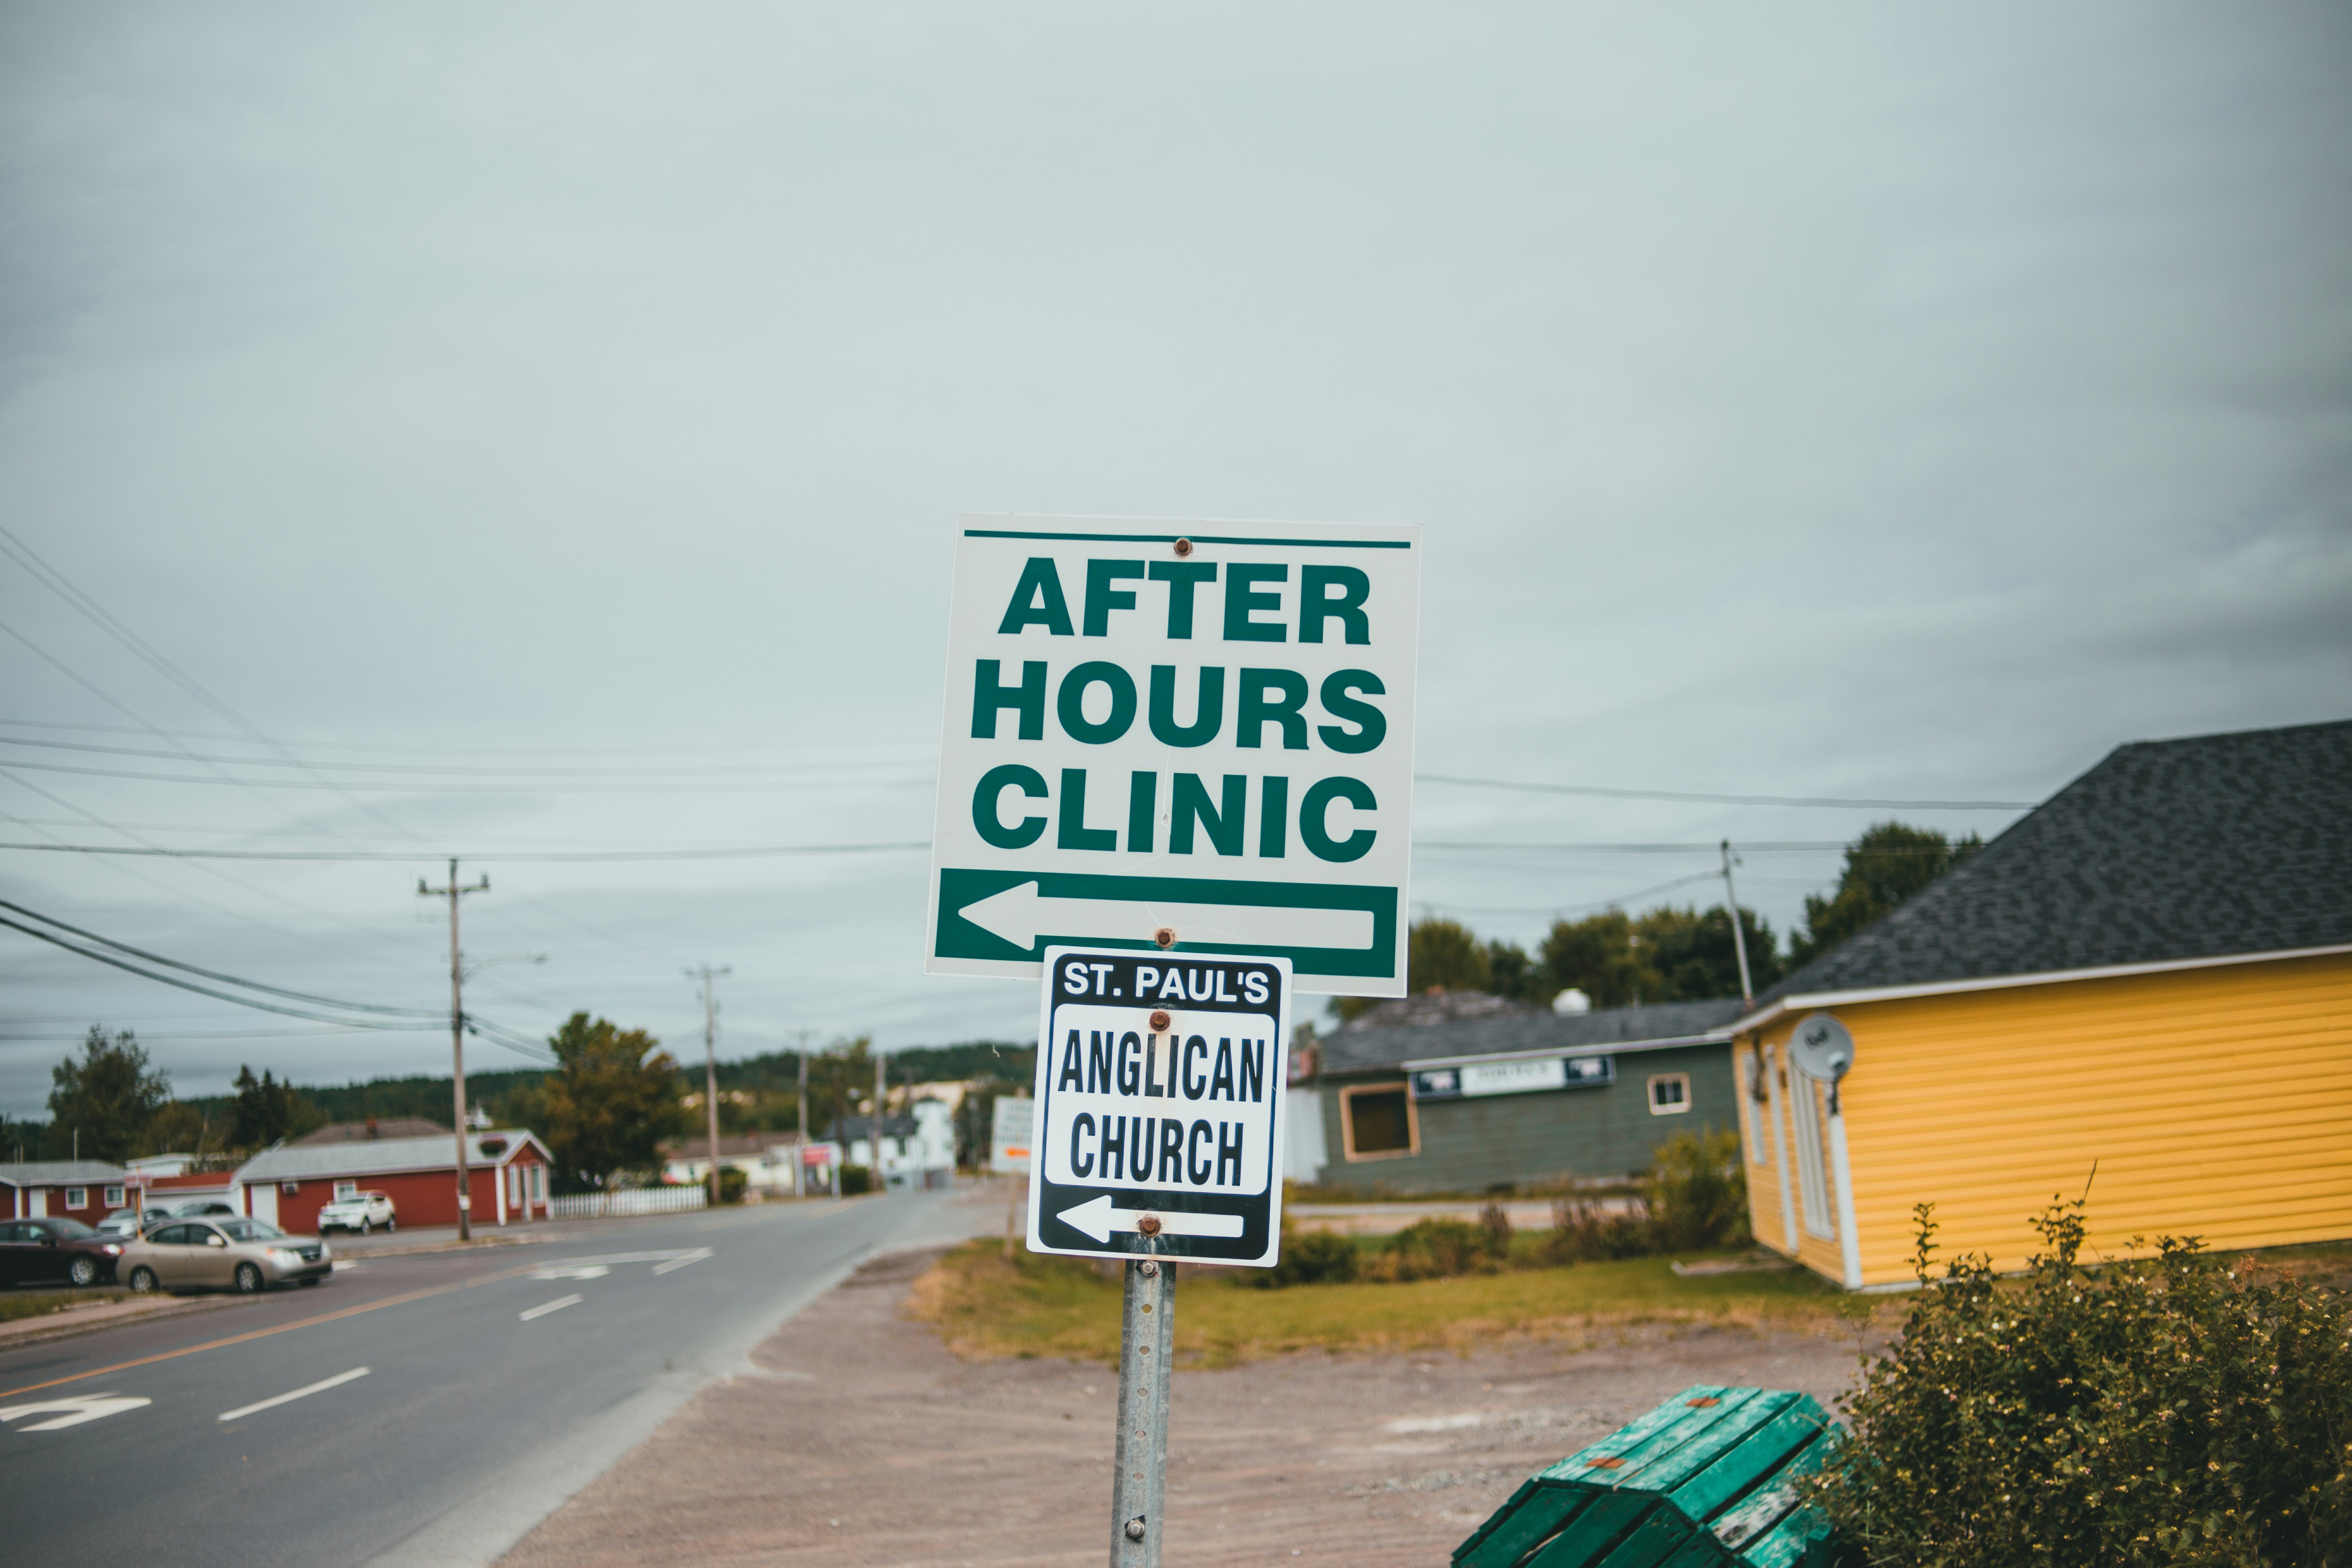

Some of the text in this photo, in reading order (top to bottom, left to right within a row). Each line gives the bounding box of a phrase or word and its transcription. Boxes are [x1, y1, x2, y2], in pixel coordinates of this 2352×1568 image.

[998, 557, 1371, 645] AFTER
[971, 659, 1387, 754] HOURS
[972, 764, 1378, 863] CLINIC
[1064, 962, 1269, 1004] ST. PAUL'S
[1058, 1029, 1265, 1103] ANGLICAN
[1070, 1112, 1244, 1186] CHURCH
